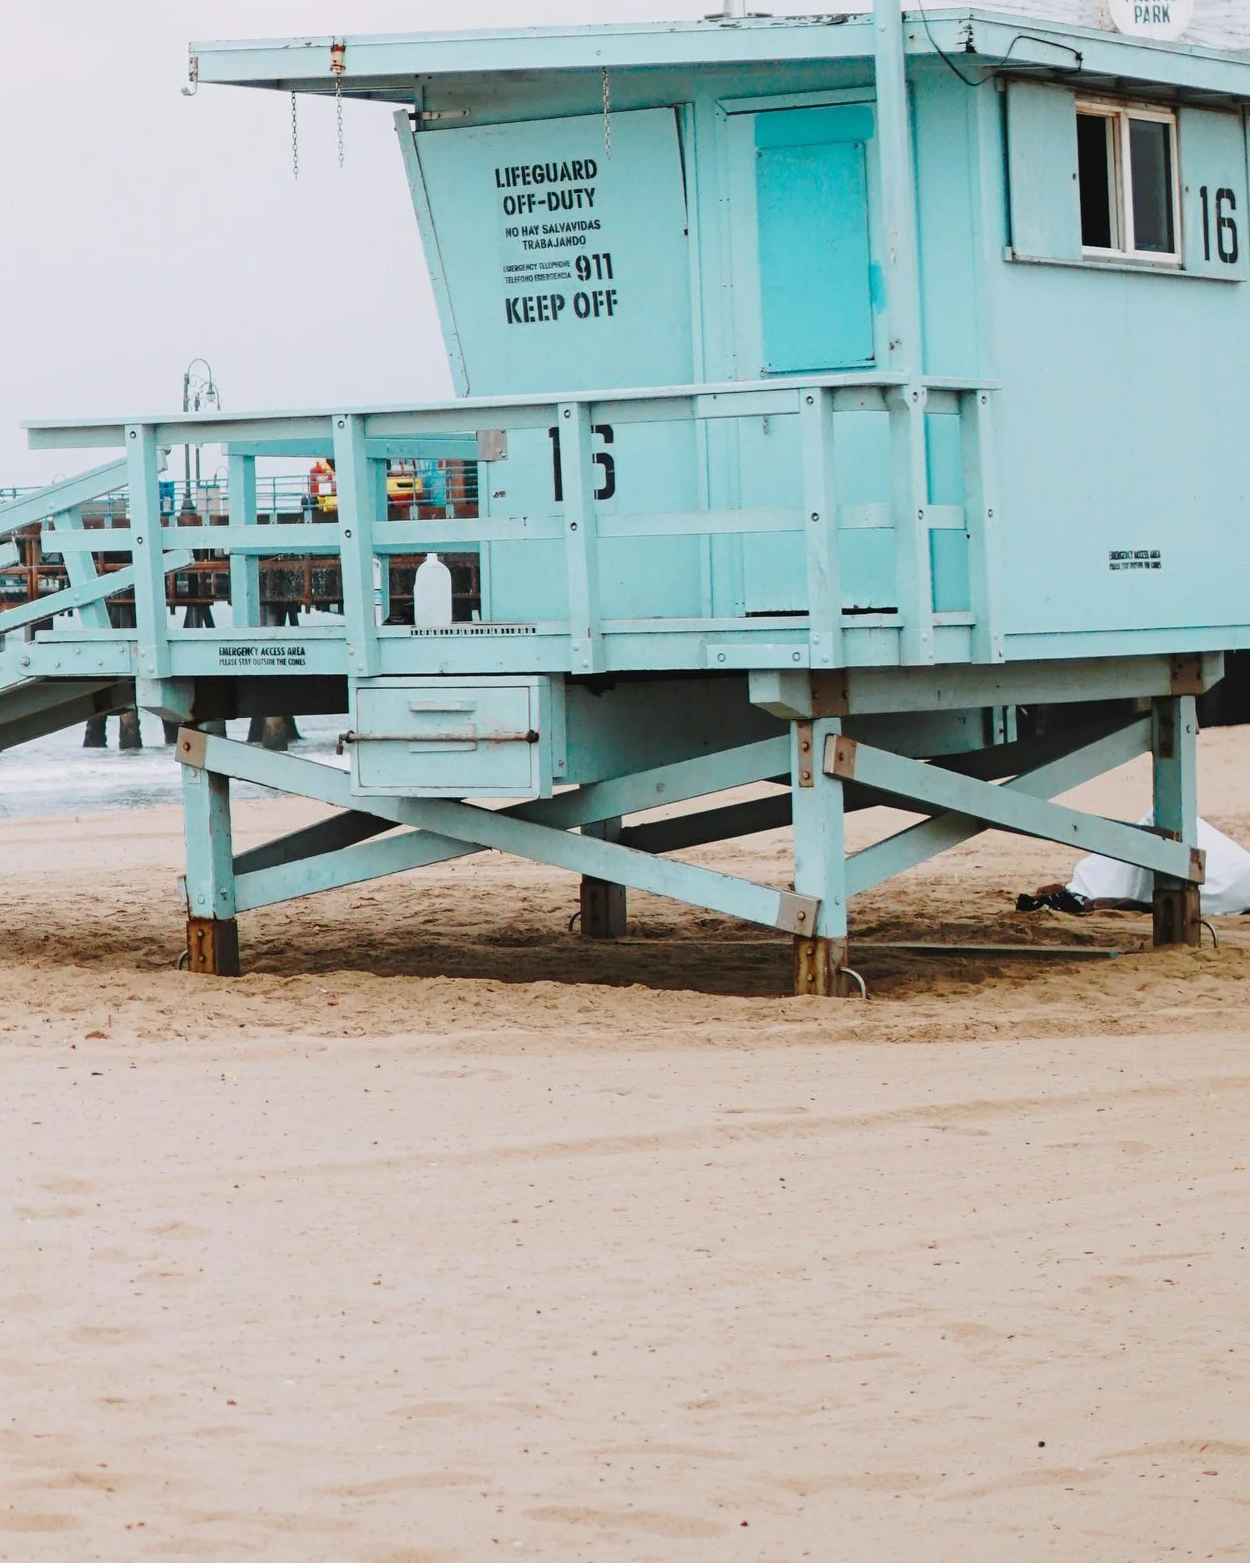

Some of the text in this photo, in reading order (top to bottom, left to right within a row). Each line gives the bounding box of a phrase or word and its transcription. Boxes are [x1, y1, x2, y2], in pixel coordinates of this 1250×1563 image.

[1134, 4, 1171, 24] PARK
[495, 159, 598, 189] LIFEGUARD
[503, 187, 596, 216] OFF-DUTY
[505, 219, 602, 238] NO HAY SALVAVIDAS
[1199, 185, 1239, 264] 16
[522, 235, 587, 251] TRABAJANDO
[575, 252, 614, 282] 911
[505, 289, 618, 325] KEEP OFF
[219, 646, 306, 656] EMERGENCY ACCESS AREA
[276, 658, 287, 666] THE
[287, 658, 306, 666] CONES
